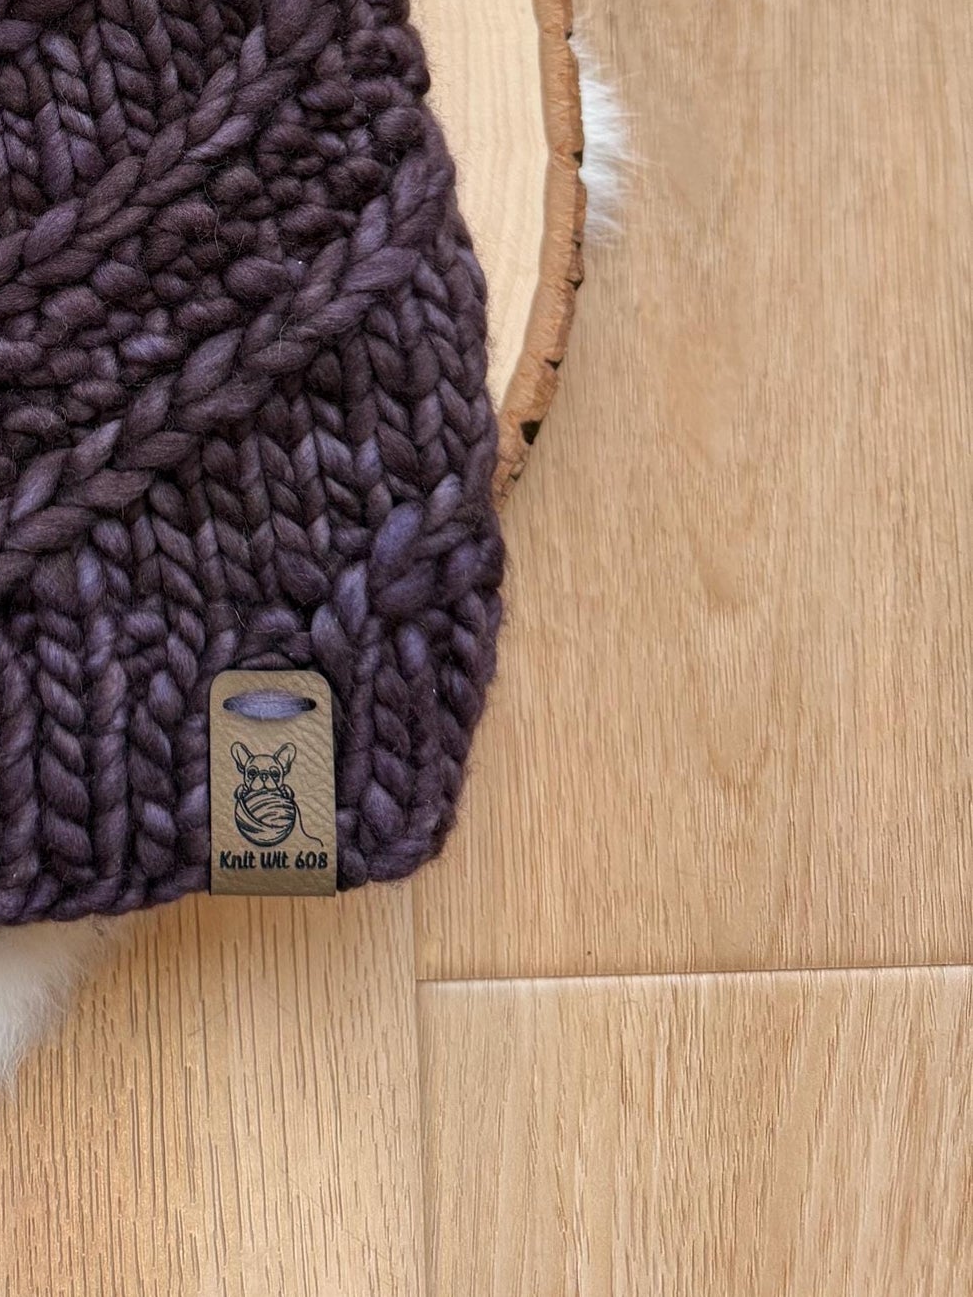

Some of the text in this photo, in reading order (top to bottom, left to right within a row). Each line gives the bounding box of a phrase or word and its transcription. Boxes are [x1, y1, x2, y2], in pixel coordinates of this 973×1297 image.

[219, 850, 328, 870] Knit Wit 608
